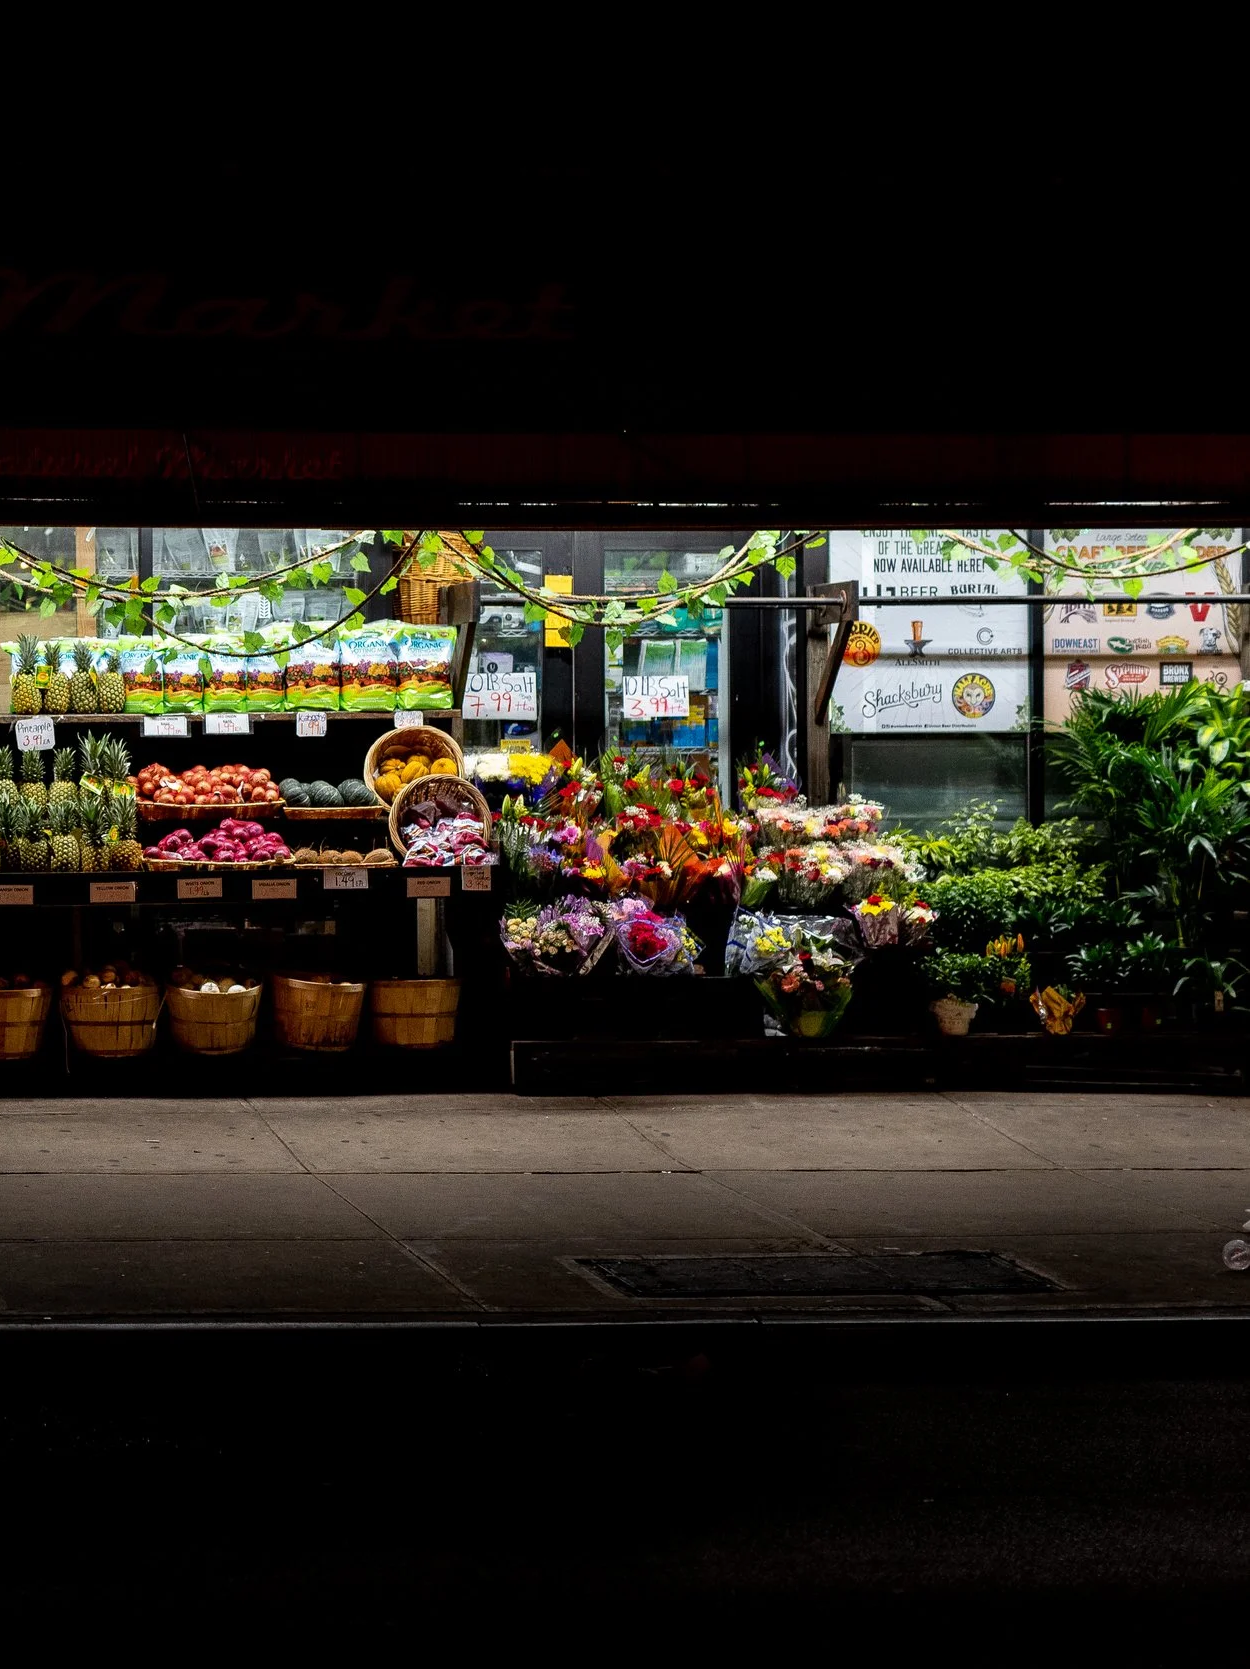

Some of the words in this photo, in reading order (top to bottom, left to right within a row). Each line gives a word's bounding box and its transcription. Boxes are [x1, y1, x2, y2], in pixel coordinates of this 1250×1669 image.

[156, 446, 344, 480] Market
[1095, 533, 1121, 544] Large
[879, 541, 889, 555] OF
[895, 541, 912, 555] THE
[874, 559, 896, 573] NOW
[900, 558, 952, 573] AVAILABLE
[957, 559, 985, 573] HERE!
[1054, 638, 1098, 648] DOWNEAST
[947, 647, 998, 655] COLLECTIVE
[1000, 647, 1023, 655] ARTS
[1162, 664, 1190, 675] BRONX
[501, 671, 534, 693] Salt
[1162, 675, 1190, 683] BREWERY
[658, 676, 688, 699] Salt
[465, 692, 511, 717] 7.99
[861, 682, 943, 718] Shacksbury
[628, 697, 668, 718] 3.99
[16, 722, 52, 734] Pineapple
